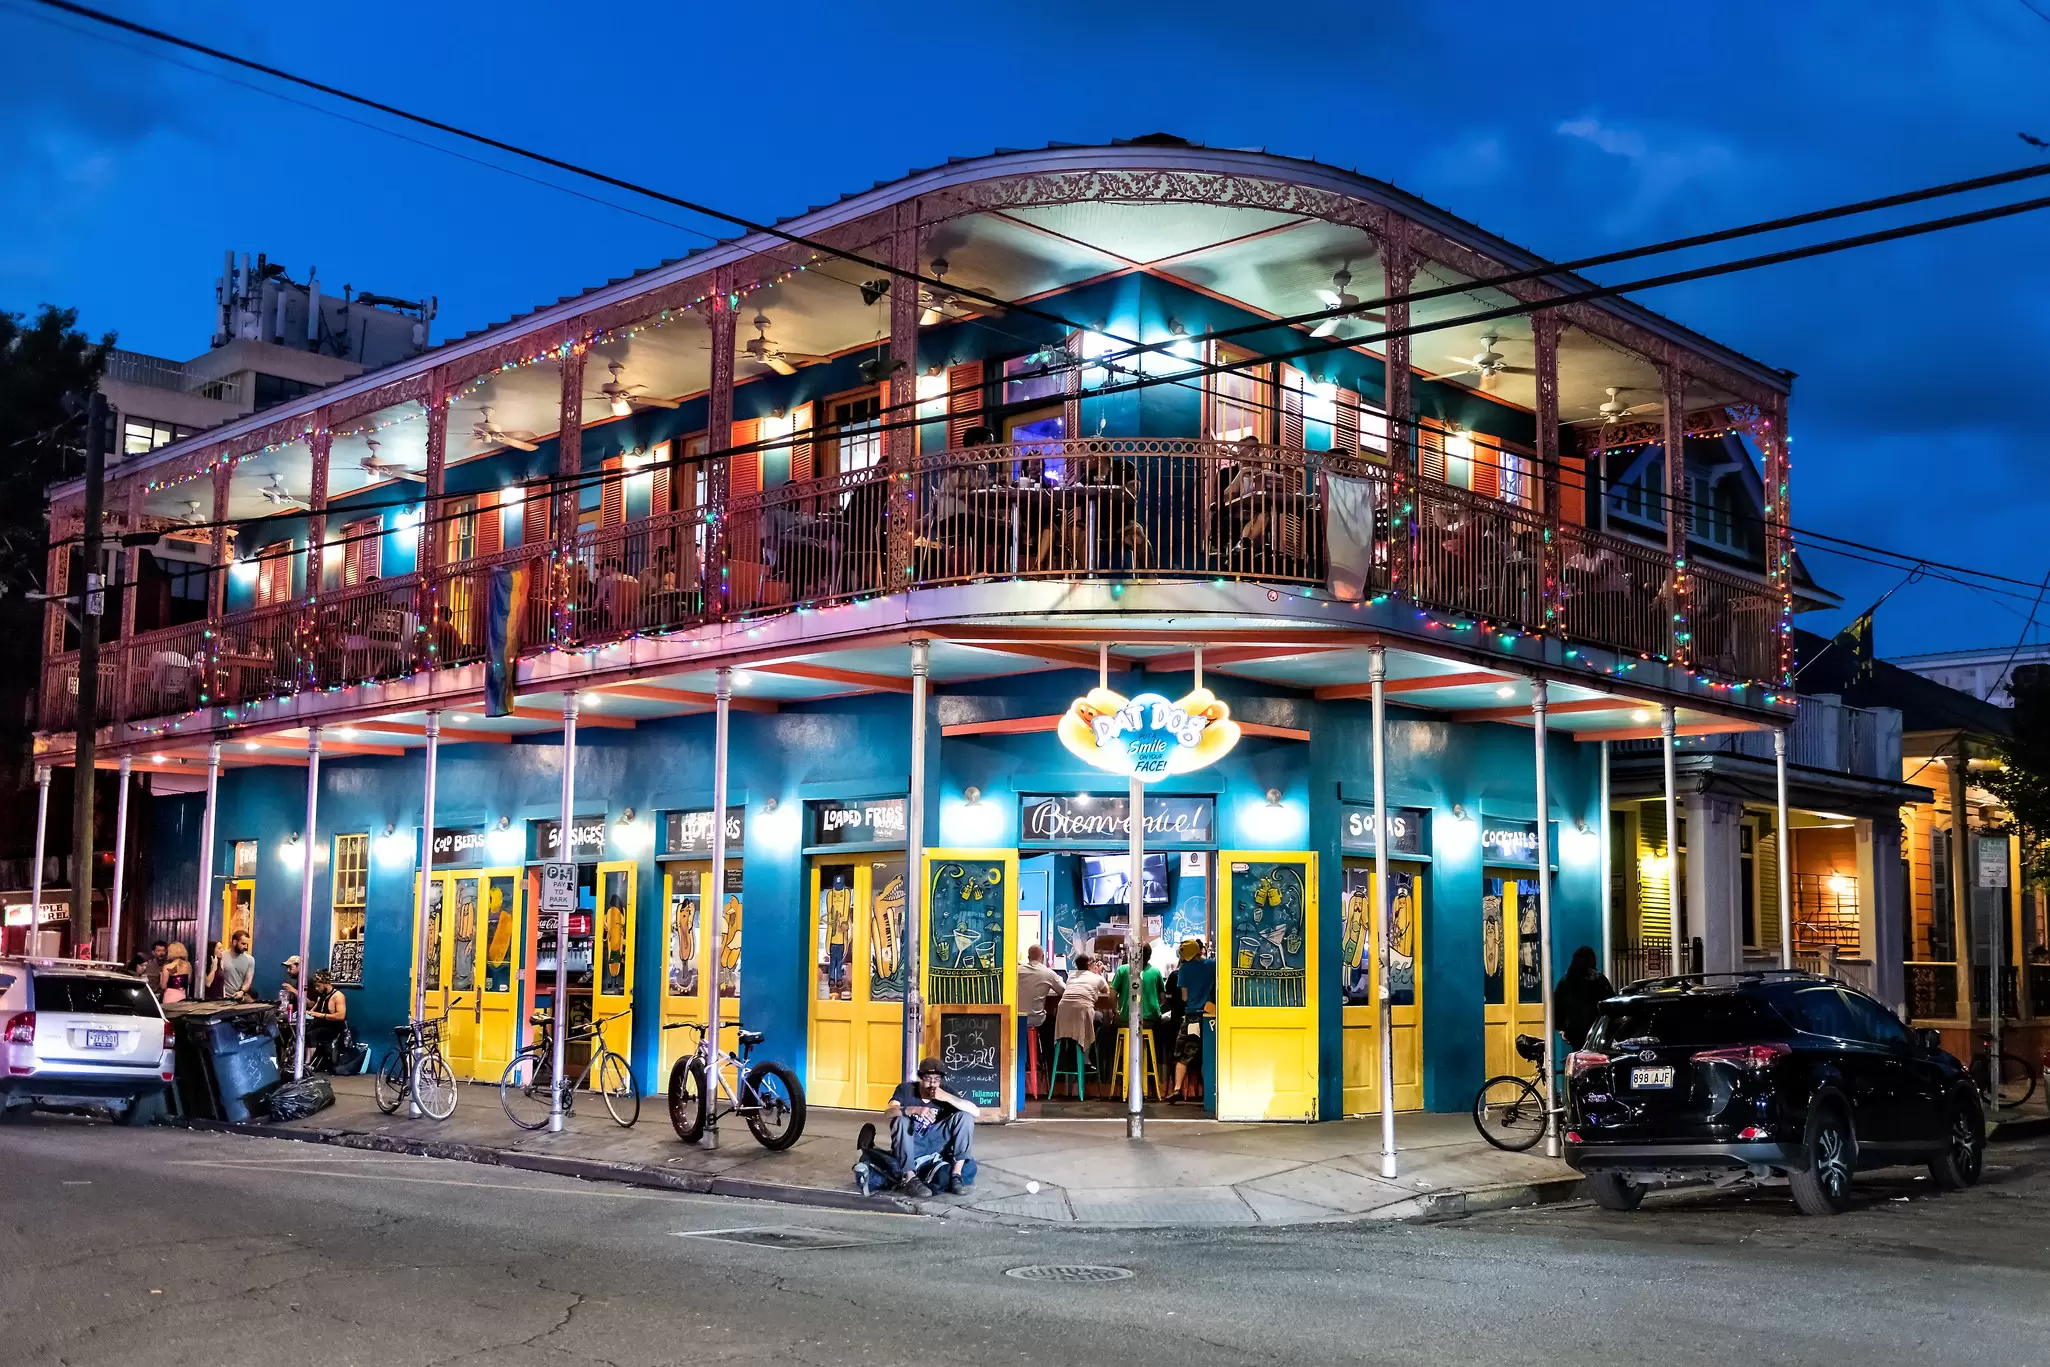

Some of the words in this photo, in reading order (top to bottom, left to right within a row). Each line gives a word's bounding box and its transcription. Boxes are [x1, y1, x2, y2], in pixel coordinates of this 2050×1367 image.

[1091, 705, 1144, 747] DAT
[1151, 703, 1207, 748] DOG
[1128, 739, 1167, 754] Smile
[1135, 760, 1167, 772] FACE!
[823, 809, 862, 831] LOADED
[433, 835, 453, 853] COLD
[454, 833, 485, 851] BEERS
[549, 825, 604, 849] SASAGES
[1481, 829, 1536, 850] COCKTAILS
[1633, 1072, 1649, 1084] 898
[1653, 1072, 1670, 1083] AJF
[971, 1089, 999, 1098] Tullamore
[979, 1097, 993, 1105] Dew
